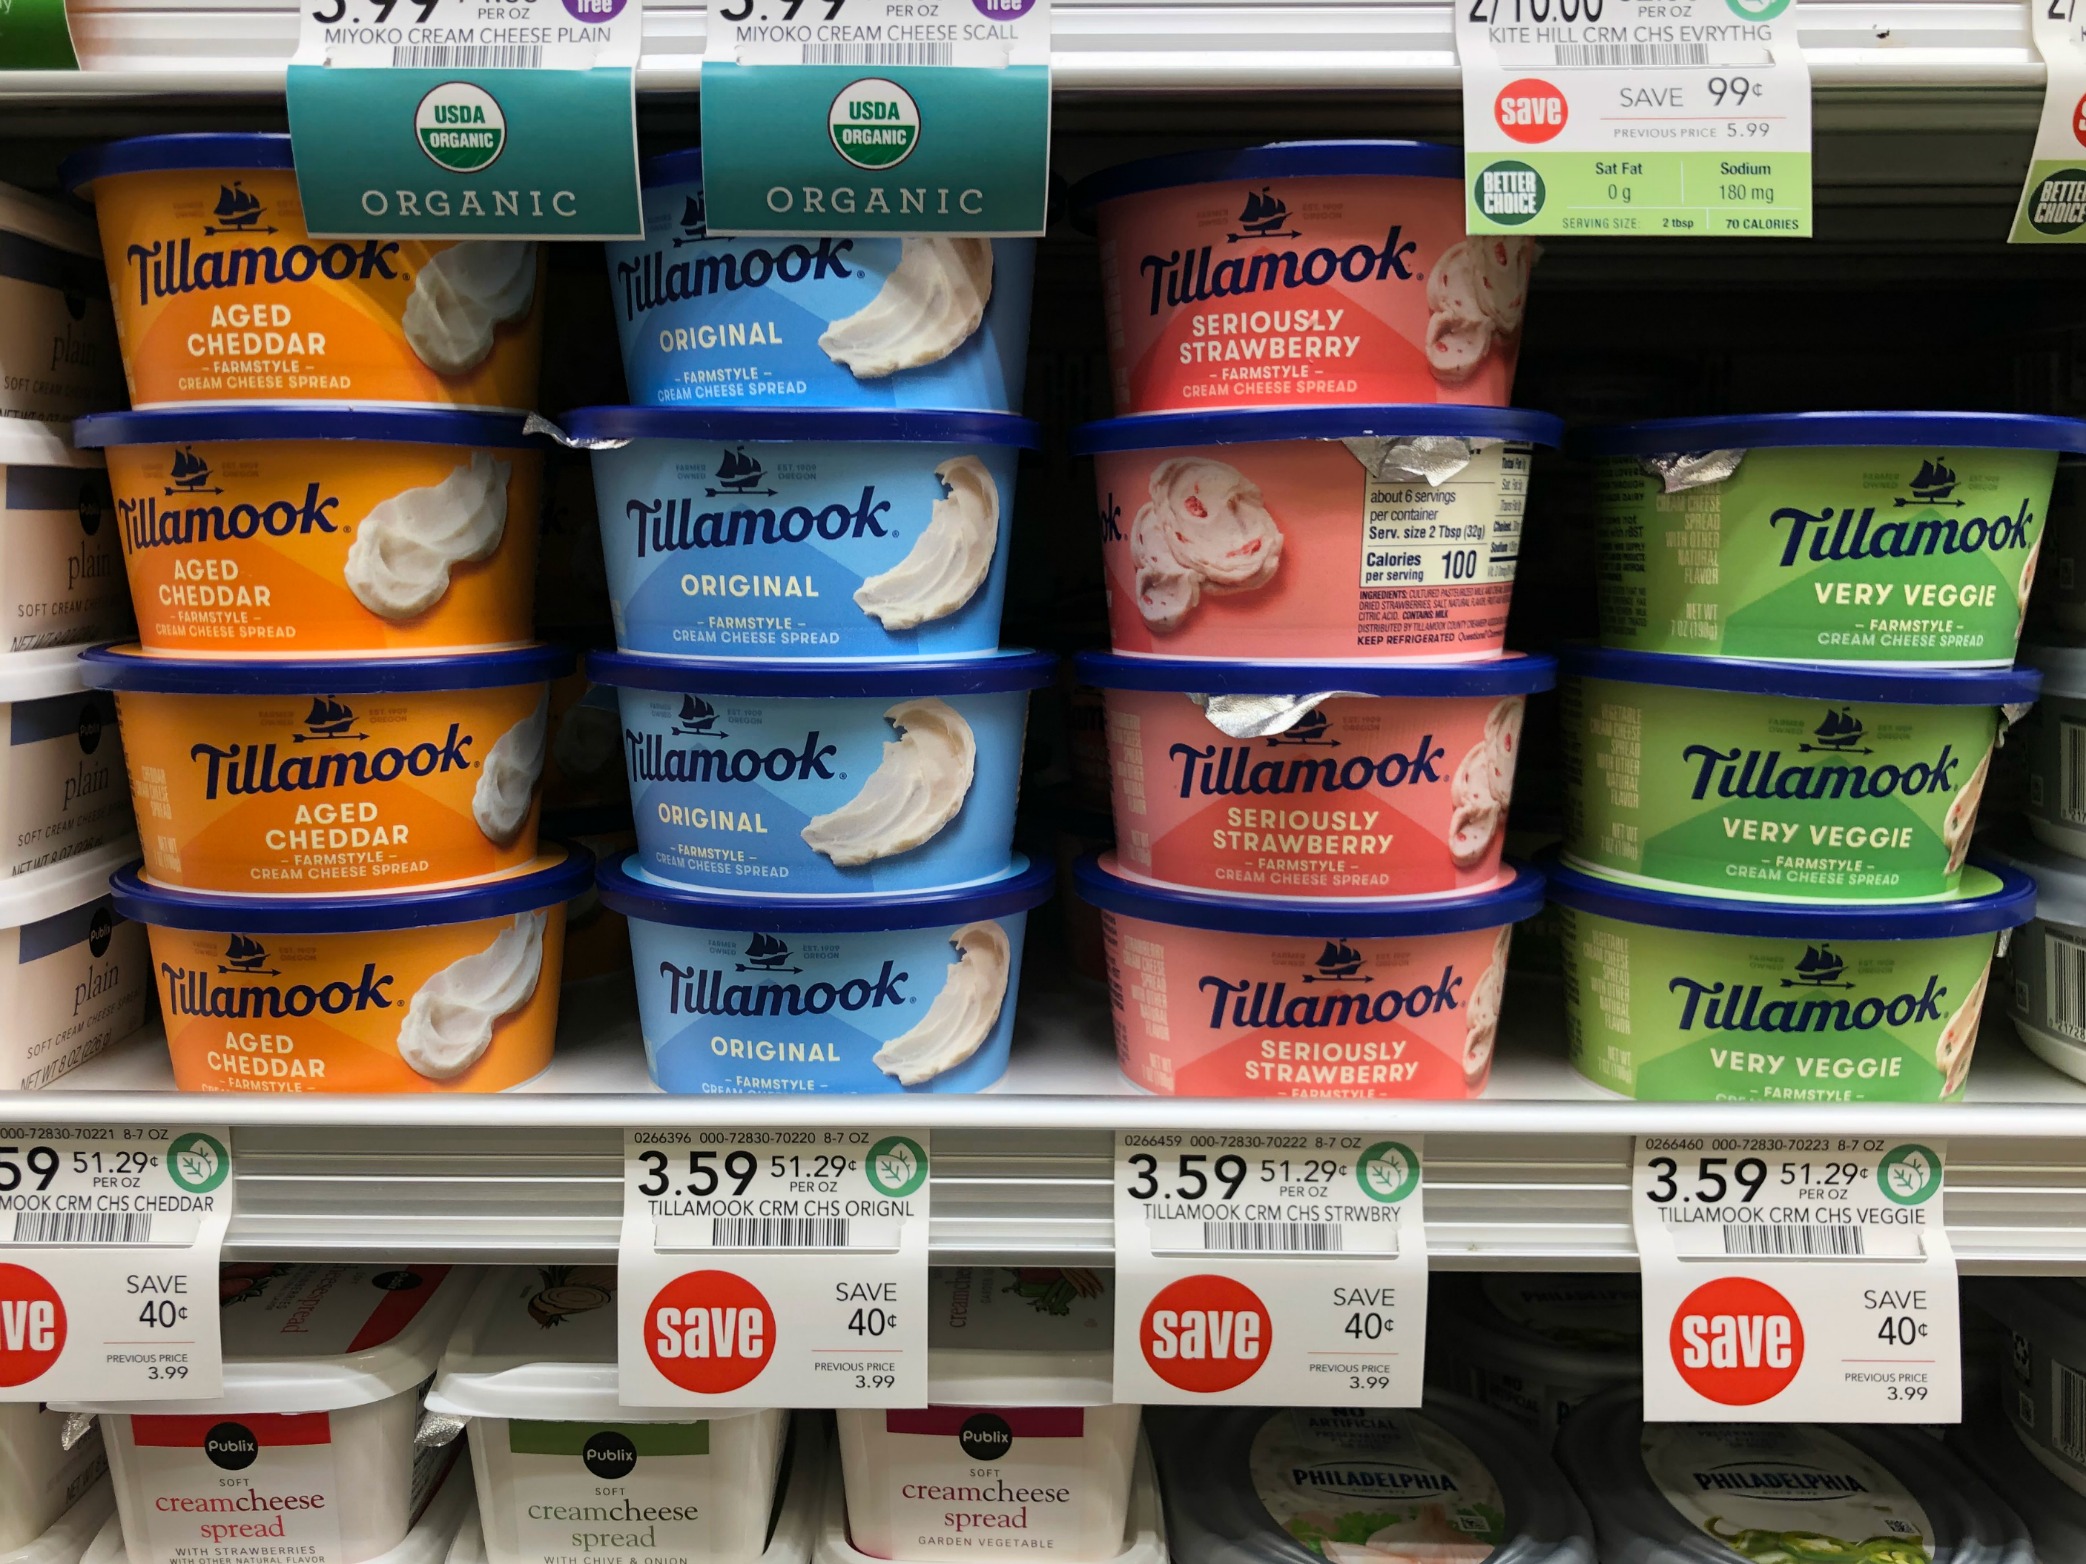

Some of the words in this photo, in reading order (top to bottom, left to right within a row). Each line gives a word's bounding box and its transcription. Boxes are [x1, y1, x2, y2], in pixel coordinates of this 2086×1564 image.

[478, 8, 505, 20] PER
[509, 8, 530, 20] OZ
[325, 28, 402, 44] MIYOKO
[408, 28, 474, 44] CREAM
[480, 28, 551, 44] CHEESE
[558, 27, 611, 43] PLAIN
[736, 25, 812, 42] MIYOKO
[817, 26, 882, 42] CREAM
[888, 25, 957, 41] CHEESE
[963, 24, 1018, 40] SCALL
[1489, 27, 1530, 43] KITE
[1536, 26, 1578, 43] HILL
[1583, 27, 1628, 43] CRM
[1634, 26, 1674, 43] CHS
[1681, 25, 1772, 42] EVRYTHG
[1620, 87, 1684, 108] SAVE
[1707, 76, 1763, 107] 99¢
[434, 105, 485, 124] USDA
[849, 101, 900, 121] USDA
[1500, 97, 1562, 125] save
[430, 133, 494, 149] ORGANIC
[842, 129, 907, 146] ORGANIC
[1614, 127, 1678, 138] PREVIOUS
[1680, 127, 1717, 138] PRICE
[1726, 122, 1770, 138] 5.99
[1595, 162, 1619, 176] Sat
[1622, 162, 1643, 175] Fat
[1720, 161, 1772, 176] Sodium
[1483, 171, 1537, 193] BETTER
[1719, 184, 1747, 200] 180
[1751, 187, 1775, 204] mg
[362, 190, 577, 216] ORGANIC
[766, 186, 984, 215] ORGANIC
[1483, 193, 1537, 214] CHOICE
[1562, 217, 1610, 230] SERVING
[1614, 217, 1641, 230] SIZE:
[1725, 218, 1740, 229] 70
[1743, 218, 1800, 230] CALORIES
[127, 238, 400, 306] Tillamook
[617, 238, 854, 322] Tillamook
[1139, 225, 1417, 316] Tillamook
[211, 304, 292, 328] AGED
[1192, 309, 1344, 337] SERIOUSLY
[187, 332, 326, 357] CHEDDAR
[659, 322, 783, 353] ORIGINAL
[1179, 336, 1361, 365] STRAWBERRY
[213, 360, 300, 374] FARMSTYLE
[178, 377, 223, 391] CREAM
[226, 376, 284, 390] CHEESE
[289, 376, 351, 389] SPREAD
[1371, 490, 1402, 503] about
[1405, 490, 1412, 502] 6
[1414, 490, 1456, 505] servings
[118, 482, 339, 555] Tillamook
[626, 485, 891, 558] Tillamook
[1370, 510, 1389, 524] per
[1391, 509, 1438, 521] container
[1369, 527, 1400, 540] Serv.
[1404, 526, 1426, 539] size
[1429, 526, 1435, 538] 2
[1439, 525, 1461, 540] Tbsp
[1770, 498, 2034, 567] Tillamook
[174, 559, 239, 581] AGED
[1366, 570, 1385, 583] per
[1386, 569, 1424, 582] serving
[1367, 553, 1421, 566] Calories
[1441, 551, 1477, 579] 100
[158, 584, 271, 607] CHEDDAR
[680, 574, 819, 598] ORIGINAL
[1814, 582, 1893, 605] VERY
[1903, 584, 1996, 607] VEGGIE
[709, 616, 792, 630] FARMSTYLE
[673, 629, 717, 643] CREAM
[721, 630, 776, 644] CHEESE
[781, 632, 840, 644] SPREAD
[1357, 636, 1383, 645] KEEP
[1387, 633, 1455, 644] REFRIGERATED
[190, 722, 472, 800] Tillamook
[626, 730, 837, 783] Tillamook
[1169, 734, 1445, 799] Tillamook
[1682, 744, 1959, 800] Tillamook
[63, 761, 110, 811] plain
[295, 801, 378, 825] AGED
[658, 803, 768, 833] ORIGINAL
[1227, 807, 1380, 831] SERIOUSLY
[265, 825, 409, 850] CHEDDAR
[1213, 829, 1394, 855] STRAWBERRY
[1722, 817, 1799, 844] VERY
[1809, 825, 1913, 849] VEGGIE
[72, 962, 119, 1016] plain
[161, 962, 394, 1019] Tillamook
[660, 960, 909, 1017] Tillamook
[1198, 964, 1463, 1029] Tillamook
[1668, 974, 1947, 1033] Tillamook
[226, 1031, 294, 1054] AGED
[710, 1036, 840, 1062] ORIGINAL
[1261, 1039, 1407, 1062] SERIOUSLY
[207, 1052, 326, 1078] CHEDDAR
[1245, 1060, 1419, 1085] STRAWBERRY
[1710, 1047, 1786, 1075] VERY
[1795, 1056, 1902, 1079] VEGGIE
[634, 1132, 692, 1144] 0266396
[700, 1132, 816, 1144] 000-72830-70220
[824, 1133, 844, 1144] 8-7
[849, 1133, 869, 1144] OZ
[638, 1150, 758, 1196] 3.59
[770, 1155, 857, 1178] 51.29¢
[1127, 1153, 1247, 1200] 3.59
[1260, 1159, 1347, 1182] 51.29¢
[1646, 1157, 1768, 1203] 3.59
[1780, 1162, 1869, 1185] 51.29¢
[790, 1182, 815, 1193] PER
[818, 1182, 838, 1193] OZ
[648, 1200, 754, 1216] TILLAMOOK
[759, 1200, 799, 1217] CRM
[804, 1200, 840, 1217] CHS
[845, 1200, 914, 1217] ORIGNL
[1657, 1207, 1764, 1223] TILLAMOOK
[1769, 1207, 1810, 1223] CRM
[1815, 1208, 1851, 1224] CHS
[1857, 1208, 1926, 1224] VEGGIE
[127, 1274, 188, 1294] SAVE
[836, 1282, 897, 1302] SAVE
[1333, 1288, 1395, 1306] SAVE
[1864, 1290, 1927, 1310] SAVE
[139, 1300, 188, 1328] 40¢
[848, 1308, 897, 1337] 40¢
[656, 1307, 764, 1359] save
[1152, 1310, 1260, 1360] save
[1344, 1313, 1394, 1340] 40¢
[1878, 1316, 1928, 1346] 40¢
[1682, 1315, 1792, 1369] save
[148, 1366, 188, 1380] 3.99
[855, 1375, 895, 1389] 3.99
[1349, 1376, 1389, 1389] 3.99
[1887, 1386, 1928, 1401] 3.99
[208, 1440, 255, 1453] Publix
[963, 1431, 1008, 1444] Publix
[587, 1449, 633, 1461] Publix
[902, 1479, 1070, 1502] creamcheese
[1292, 1468, 1458, 1492] PHILADELPHIA
[1693, 1472, 1869, 1494] PHILADELPHIA
[155, 1488, 325, 1513] creamcheese
[528, 1499, 699, 1521] creamcheese
[200, 1515, 285, 1544] spread
[944, 1506, 1027, 1532] spread
[572, 1525, 656, 1552] spread
[918, 1536, 972, 1546] GARDEN
[978, 1538, 1054, 1549] VEGETABLE
